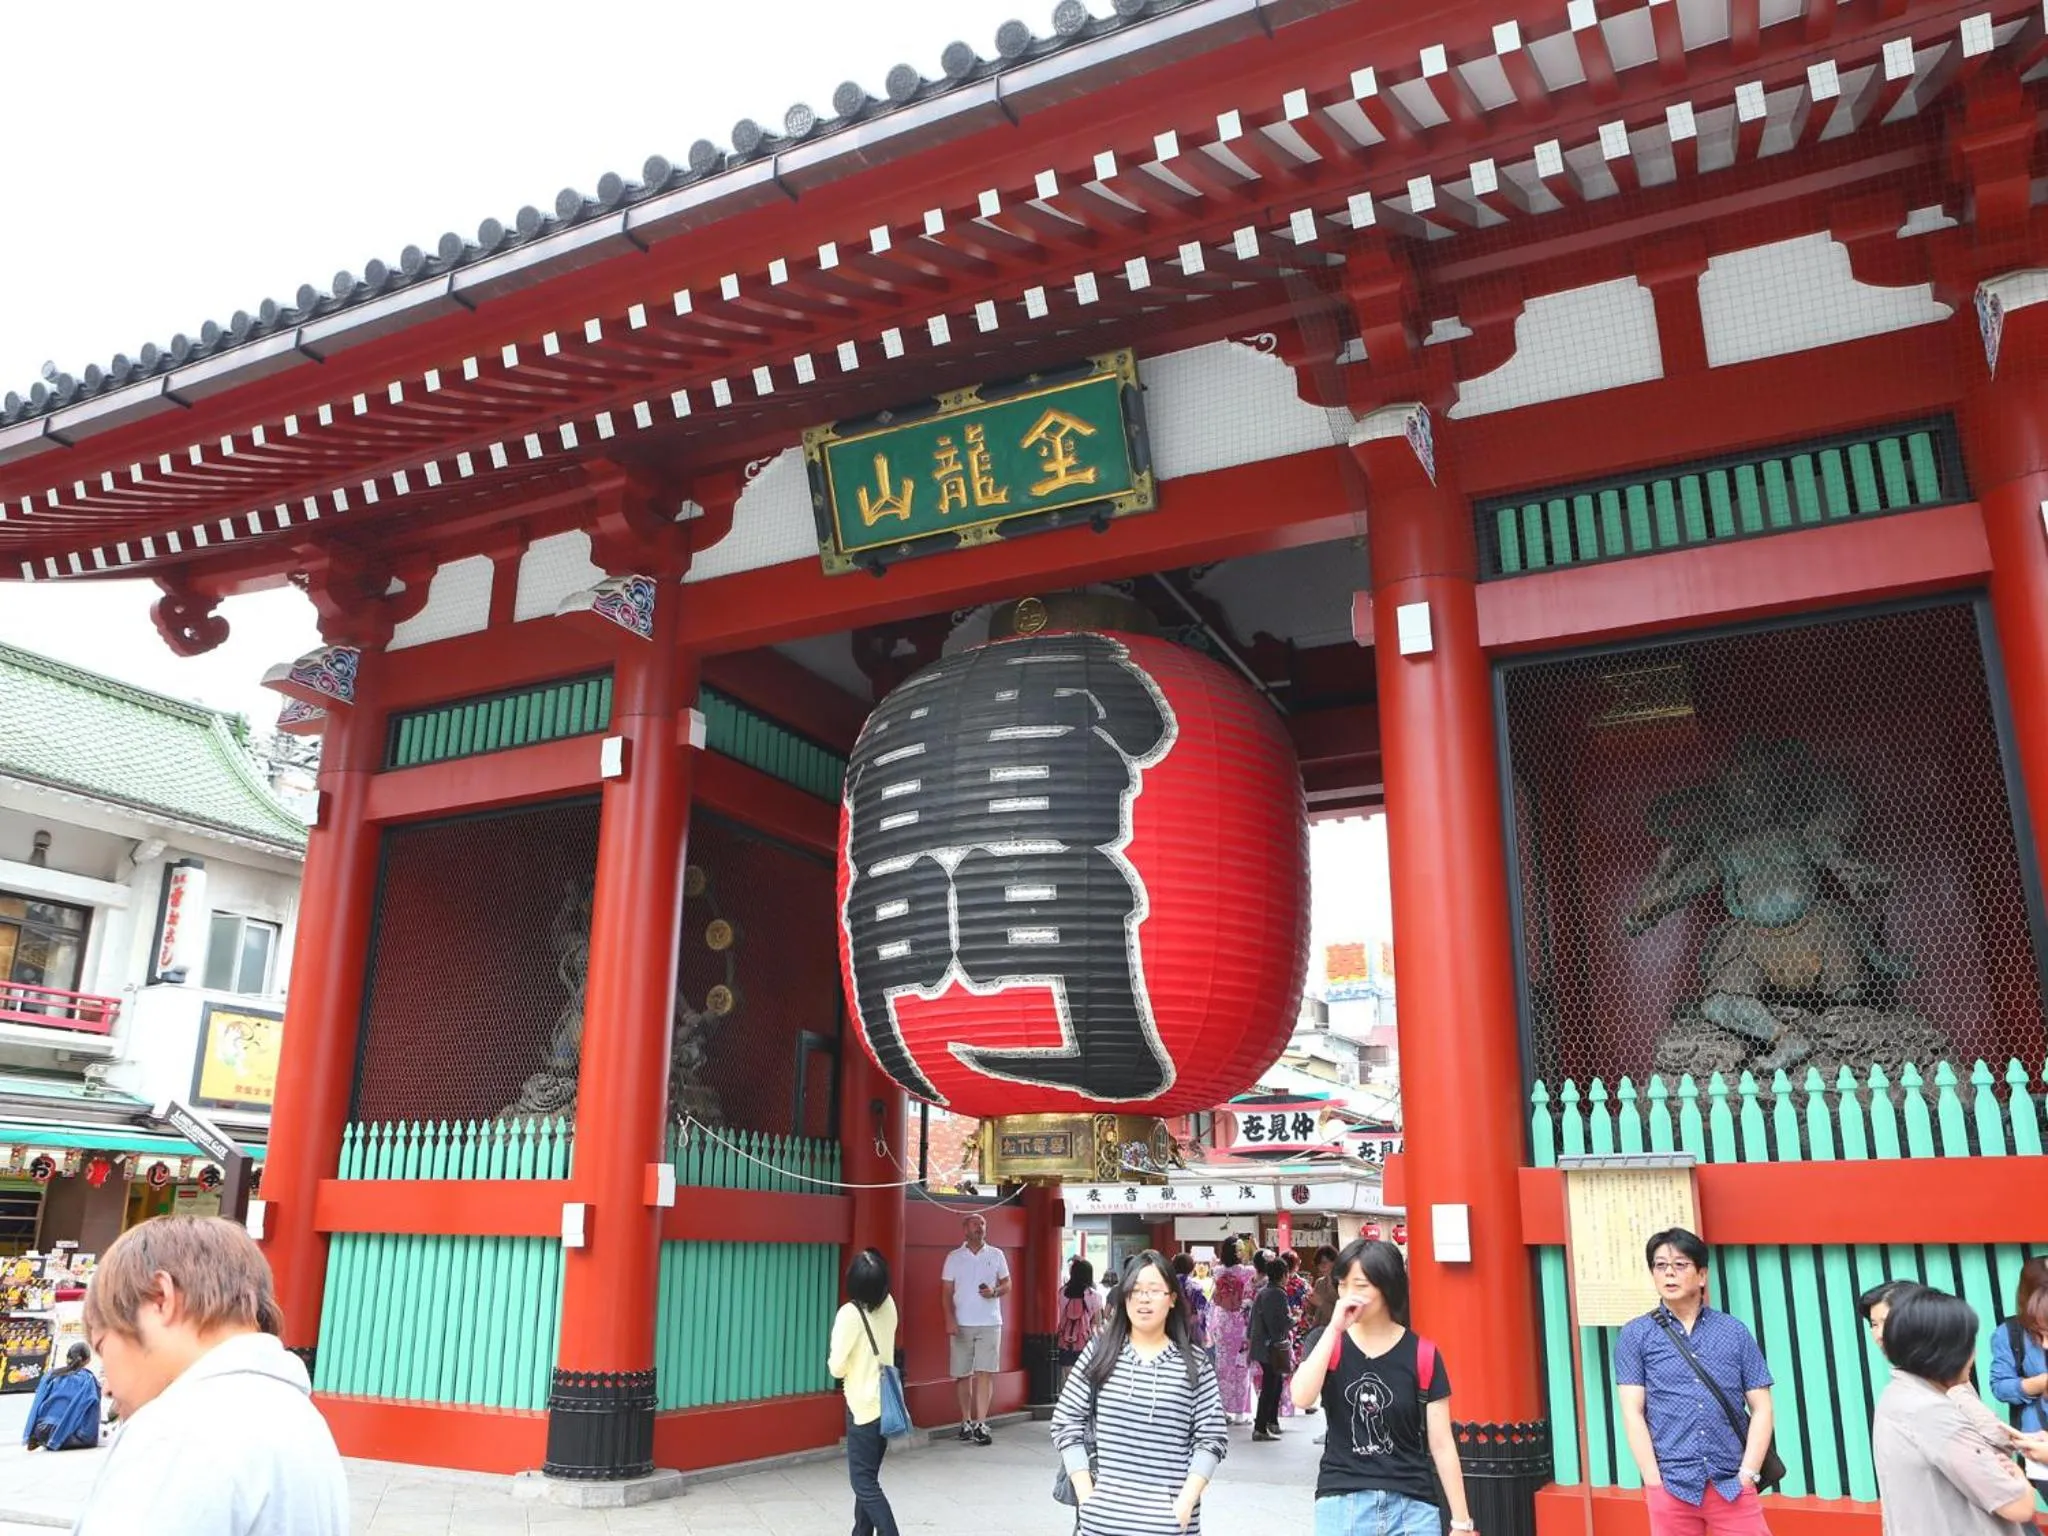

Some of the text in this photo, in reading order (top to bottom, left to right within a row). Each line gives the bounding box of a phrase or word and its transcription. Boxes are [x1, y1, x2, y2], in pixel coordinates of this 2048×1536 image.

[855, 408, 1097, 528] 金龍山
[1357, 1139, 1404, 1164] 見世
